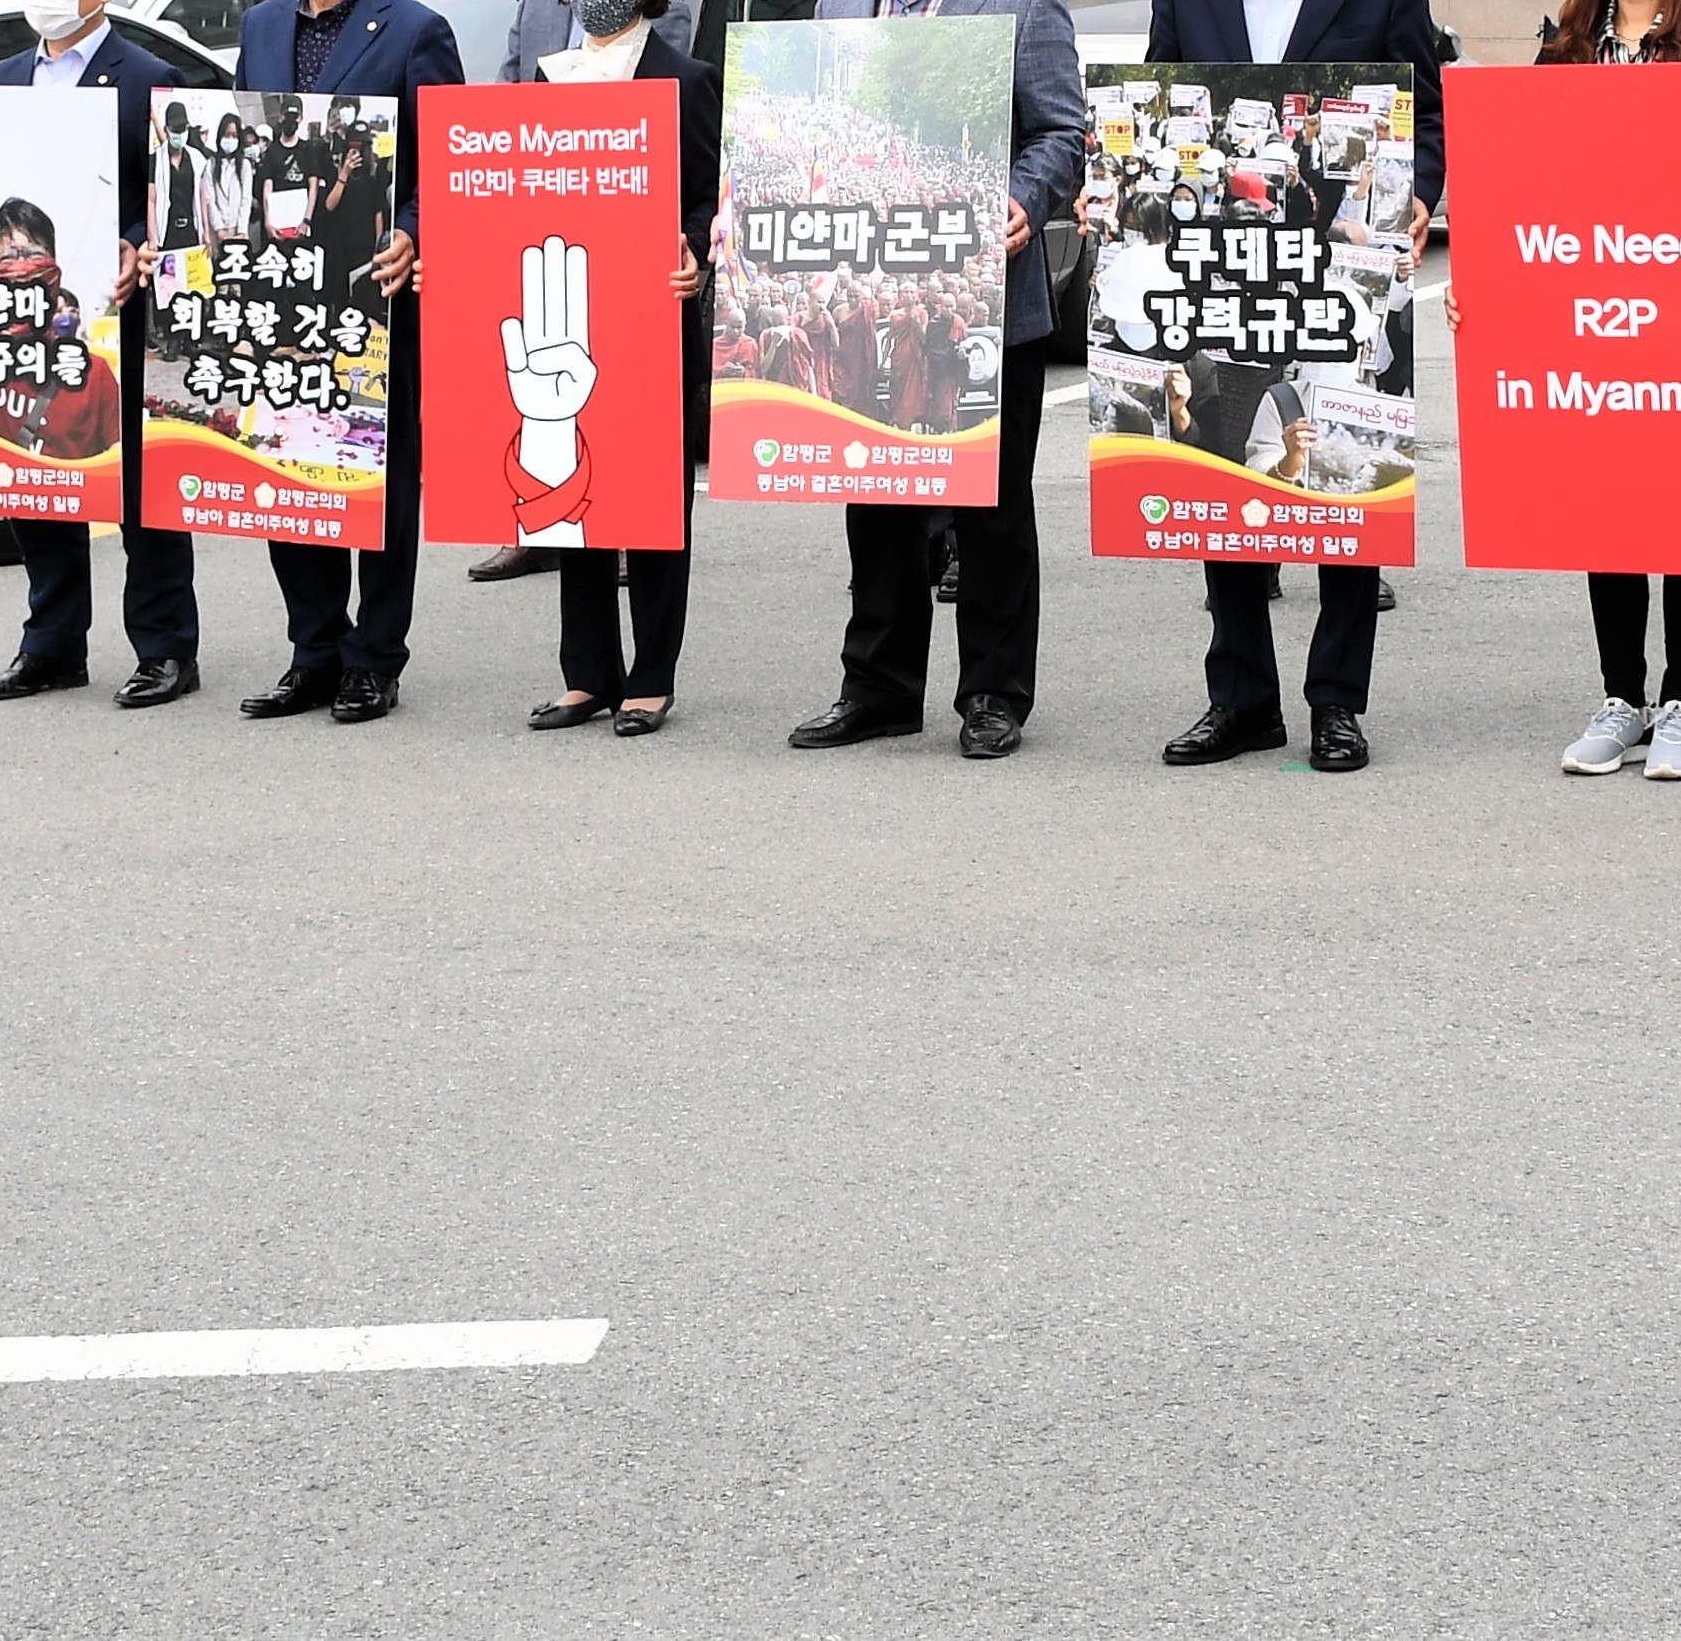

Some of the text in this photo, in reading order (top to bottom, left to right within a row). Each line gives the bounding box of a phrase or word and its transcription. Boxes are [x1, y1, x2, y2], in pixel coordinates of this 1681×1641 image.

[1394, 98, 1412, 110] ST
[449, 118, 647, 156] Save Myanmar!
[450, 166, 648, 197] 미얀마 쿠테타 반대!
[747, 208, 974, 263] 미얀마 군부
[1515, 225, 1581, 264] We
[215, 243, 325, 289] 조속히
[1172, 227, 1323, 284] 쿠데타
[170, 297, 368, 353] 회복할 것을
[1149, 295, 1348, 354] 강력규탄
[1574, 298, 1657, 337] R2P
[187, 356, 348, 409] 촉구한다.
[1497, 371, 1533, 408] in
[782, 444, 953, 467] 함평군 함평군의회
[15, 465, 85, 488] 함평군의회
[756, 474, 948, 497] 동남아 결혼이주여성 일동
[52, 494, 81, 515] 일동
[202, 482, 347, 511] 함평군 함평군의회
[1172, 499, 1365, 527] 함평군 함평군의회
[181, 507, 342, 537] 동남아 결혼이주여성 일동
[1145, 529, 1359, 558] 동남아 결혼이주여성 일동
